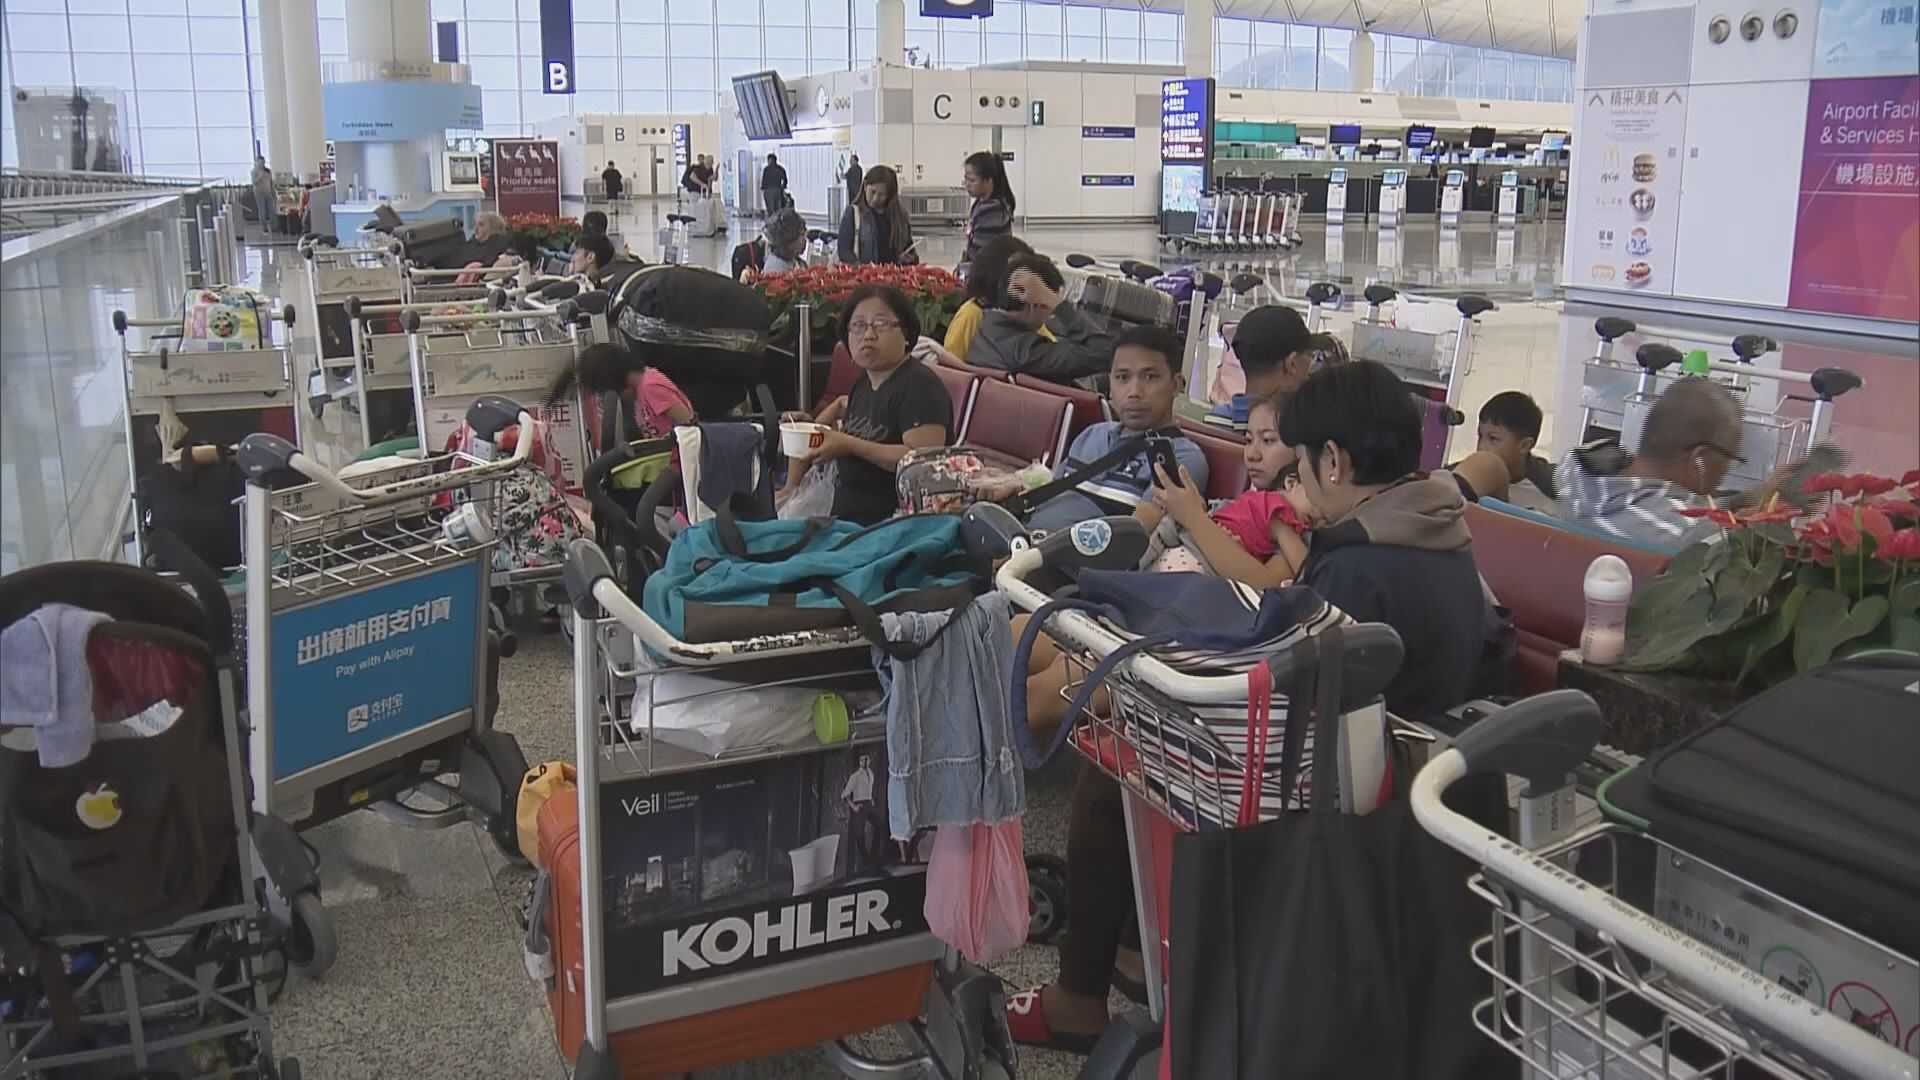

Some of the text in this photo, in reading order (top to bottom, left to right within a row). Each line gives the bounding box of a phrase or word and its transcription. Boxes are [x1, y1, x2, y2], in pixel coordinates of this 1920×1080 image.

[549, 62, 568, 91] B
[933, 94, 952, 120] C
[1823, 99, 1919, 123] Airport Facil
[614, 127, 625, 142] B
[1820, 125, 1833, 145] &
[1836, 124, 1905, 145] Services
[500, 176, 557, 186] Priority seats
[1835, 162, 1919, 187] 機場設施
[335, 646, 415, 679] Pay with Alipay
[621, 792, 660, 817] Veil
[663, 889, 891, 977] KOHLER
[1640, 914, 1682, 942] PRESS
